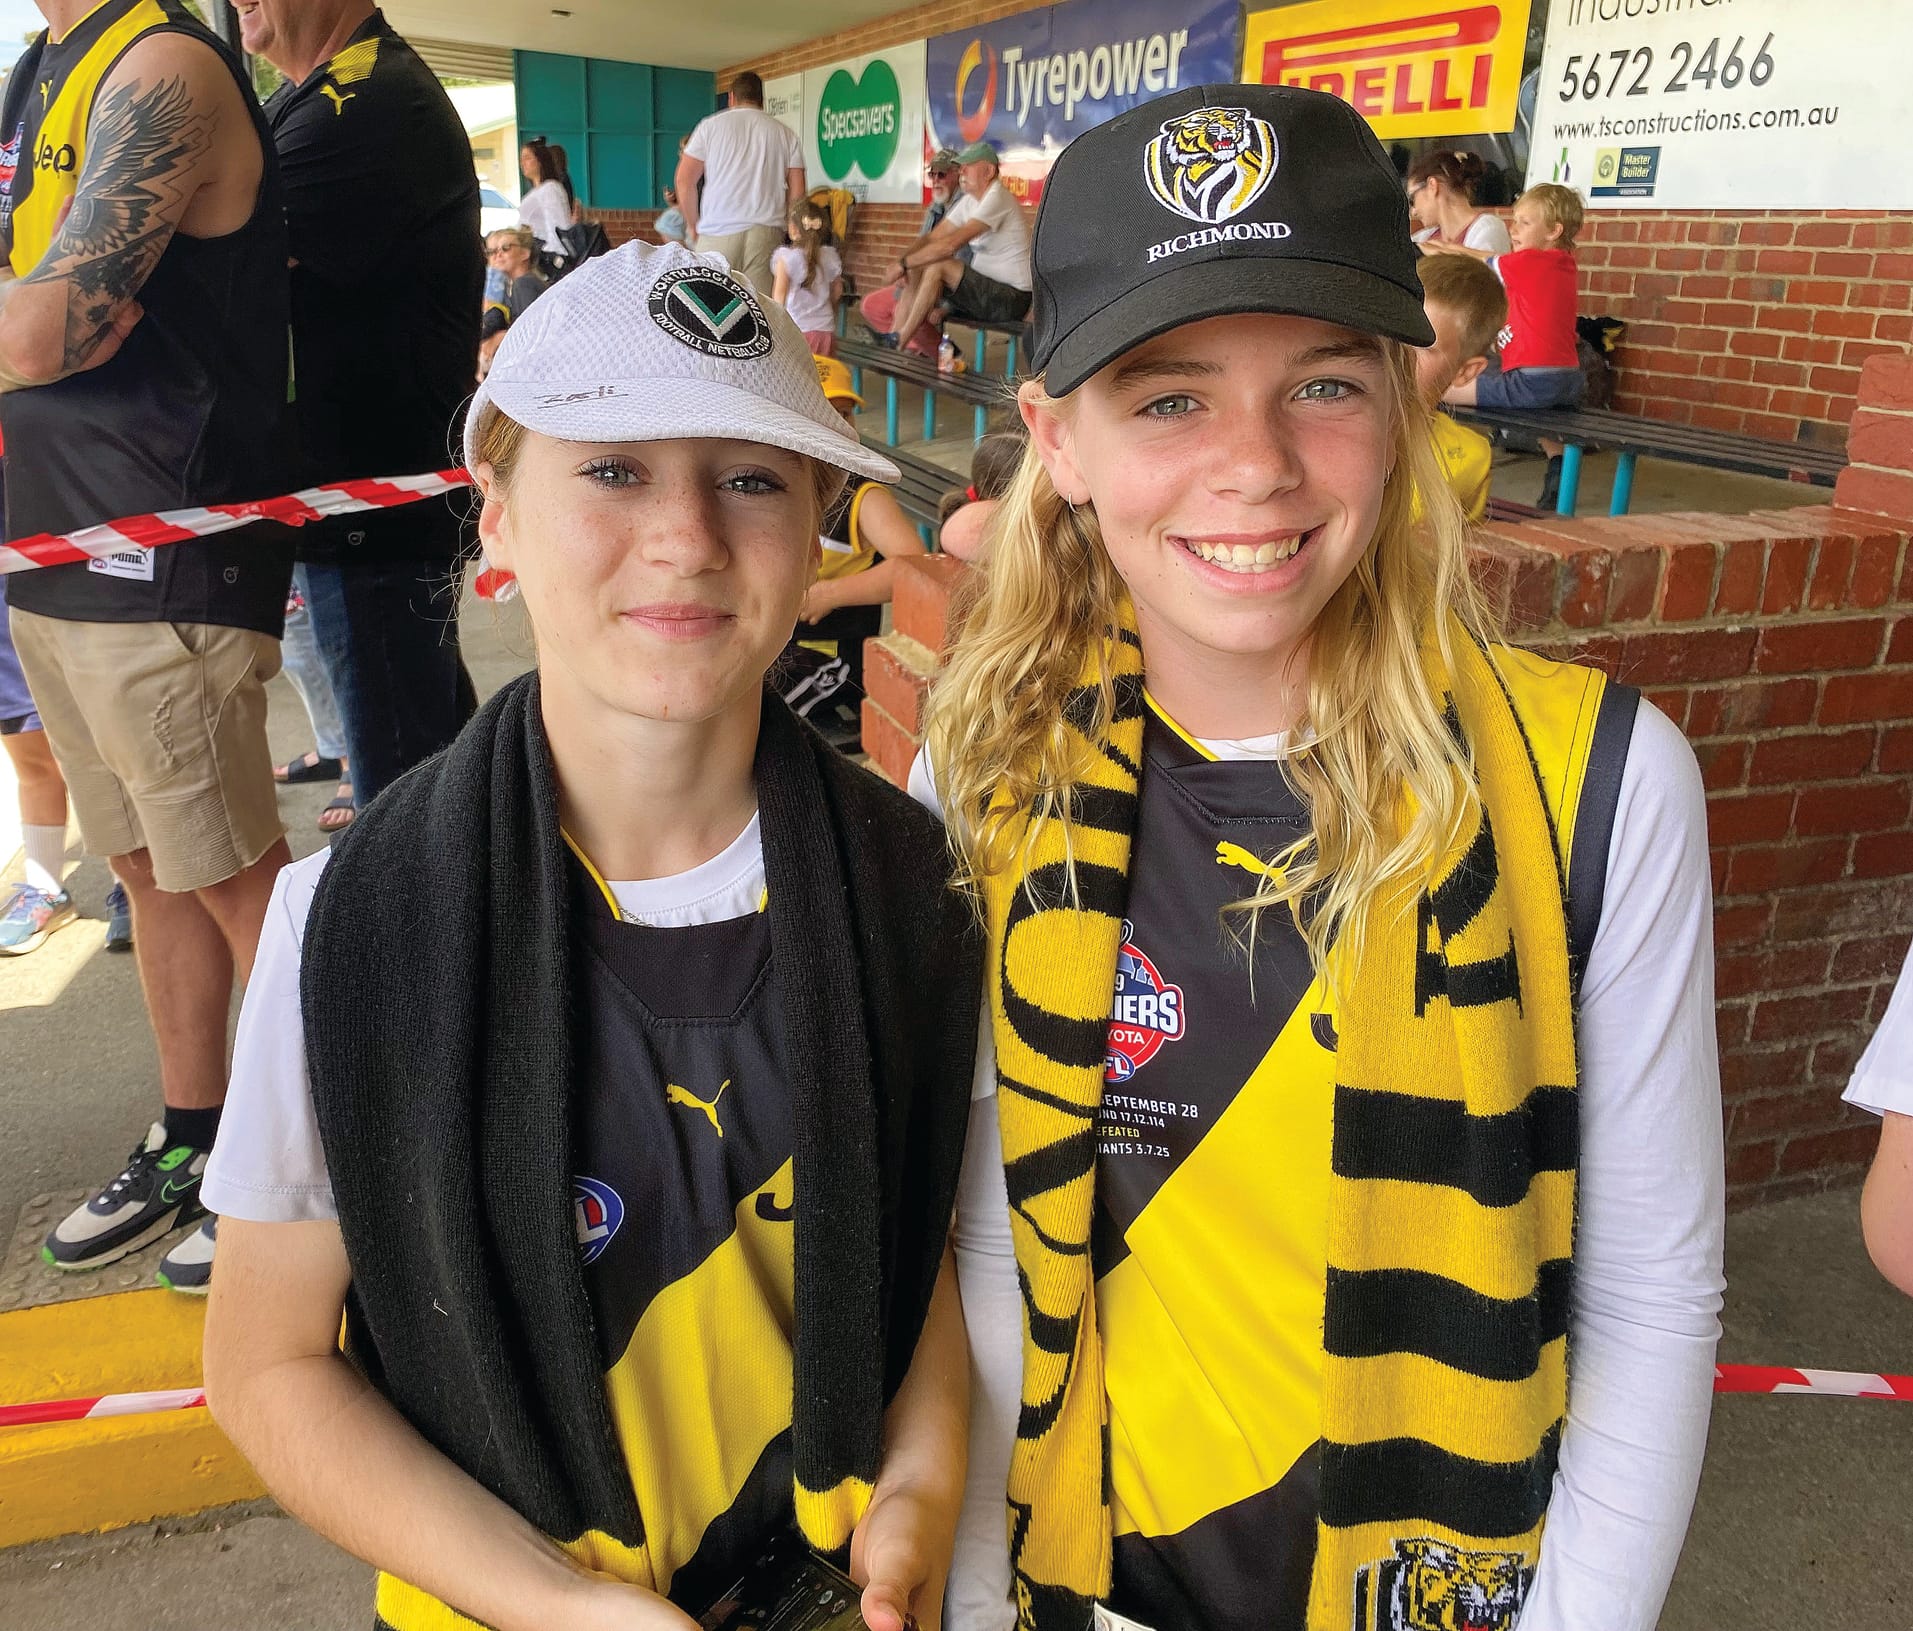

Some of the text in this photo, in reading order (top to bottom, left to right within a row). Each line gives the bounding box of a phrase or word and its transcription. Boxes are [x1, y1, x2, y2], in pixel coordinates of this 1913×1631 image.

[1003, 28, 1190, 128] Tyrepower
[1262, 5, 1502, 116] PELLI
[1559, 32, 1775, 102] 5672 2466
[822, 103, 895, 147] Specsavers
[1553, 105, 1839, 139] www.tsconstructions.com.au
[1622, 166, 1650, 178] Builder
[1624, 154, 1651, 166] Master
[1146, 222, 1292, 263] RICHMOND
[730, 283, 768, 327] POWER
[653, 313, 702, 350] FOOTBALL
[707, 343, 759, 358] NETBALL
[1111, 991, 1178, 1034] IERS
[1099, 1109, 1165, 1128] ND 17.12.114
[1102, 1094, 1198, 1118] EPTEMBER 28
[1136, 1143, 1170, 1157] 3.7.25
